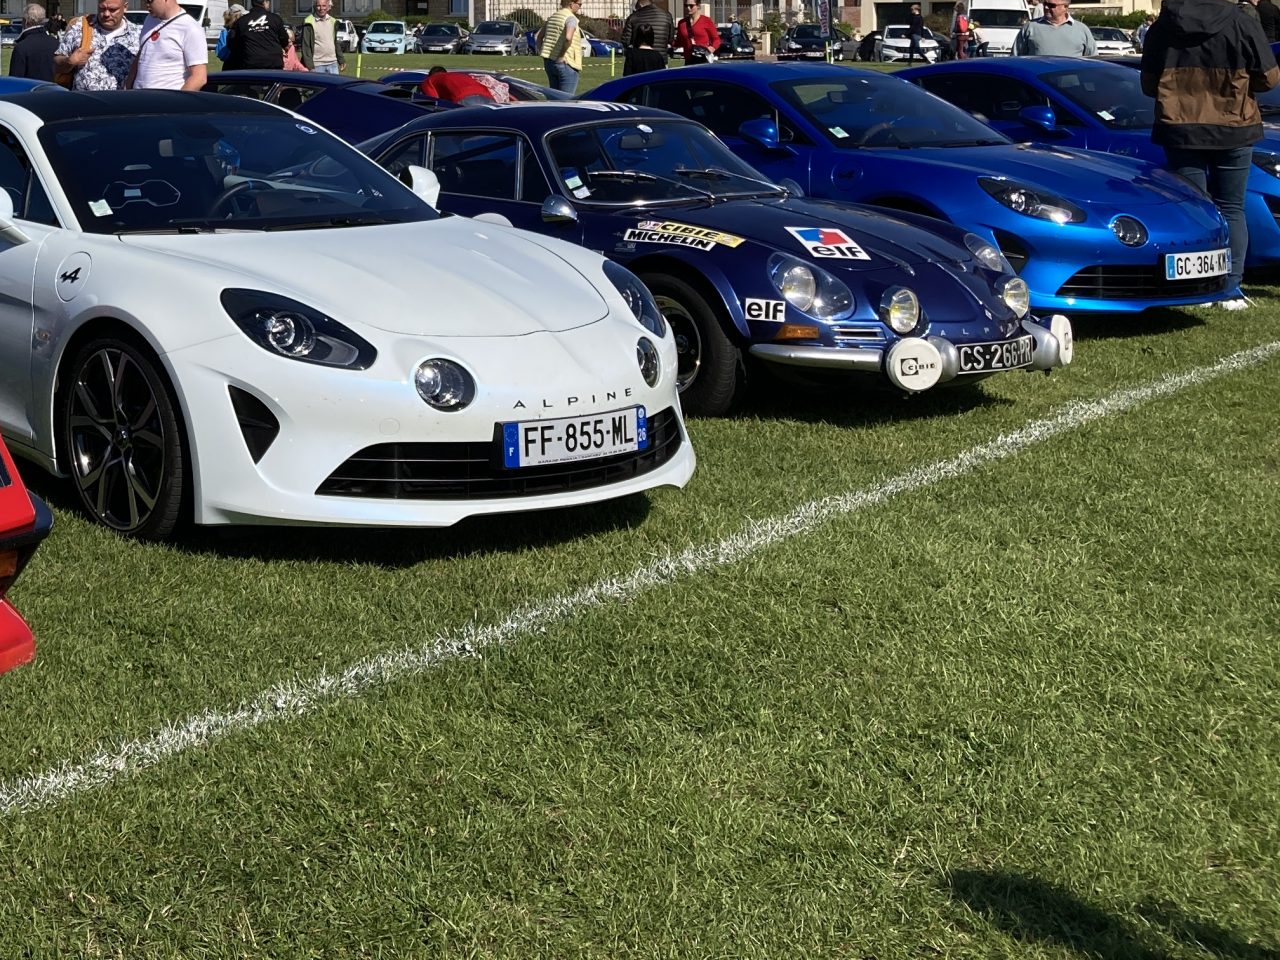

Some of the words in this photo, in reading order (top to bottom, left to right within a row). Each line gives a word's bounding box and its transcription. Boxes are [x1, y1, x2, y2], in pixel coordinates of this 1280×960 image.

[627, 230, 709, 249] MICHELIN
[811, 245, 863, 258] elf
[746, 301, 784, 321] elf
[960, 338, 1031, 371] CS-266-PR
[513, 387, 633, 409] ALPINE
[523, 414, 635, 458] FF-855-ML
[638, 427, 646, 441] 26
